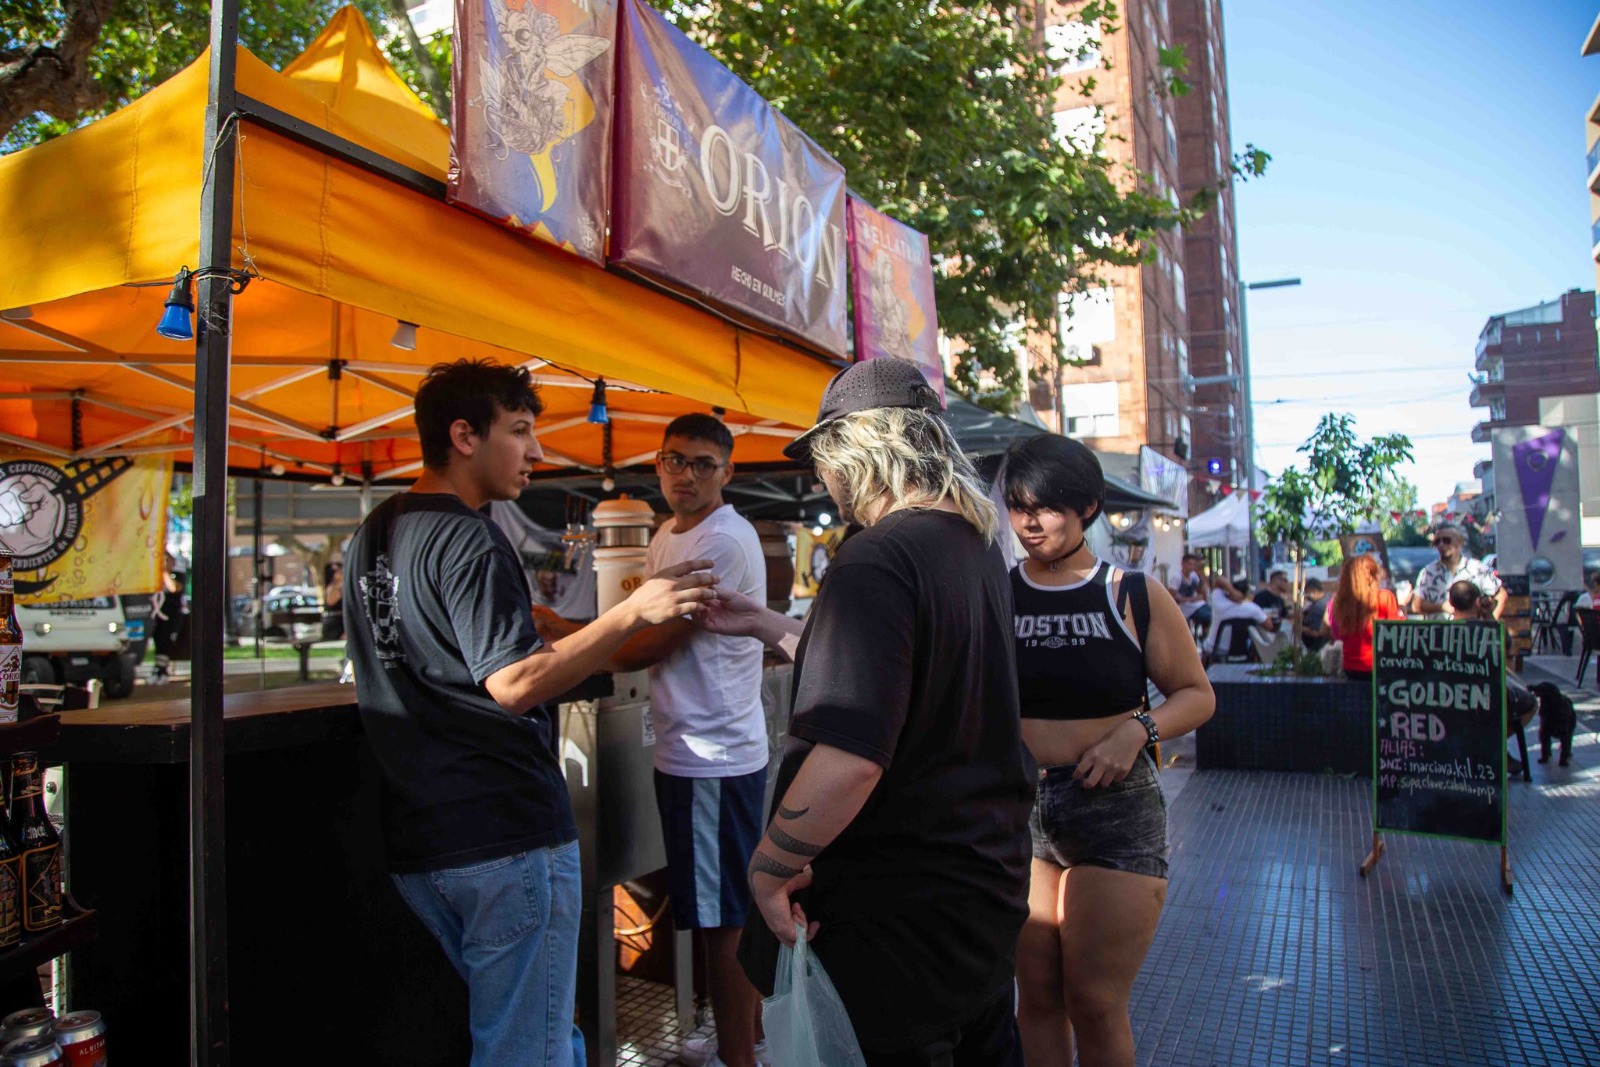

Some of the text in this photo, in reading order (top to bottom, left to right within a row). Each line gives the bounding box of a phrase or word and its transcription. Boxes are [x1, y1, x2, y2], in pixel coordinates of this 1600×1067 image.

[653, 102, 682, 132] ORION
[700, 124, 843, 296] ORION
[731, 265, 752, 289] HECHO
[752, 277, 763, 295] EN
[9, 463, 63, 483] CERVECEROS
[12, 549, 58, 569] ENDIENTES
[1025, 639, 1038, 648] 19
[1071, 637, 1086, 647] 98
[2, 672, 20, 681] ORIO
[1380, 655, 1490, 677] cerveza artesanal
[1388, 680, 1490, 710] GOLDEN
[1390, 712, 1446, 742] RED
